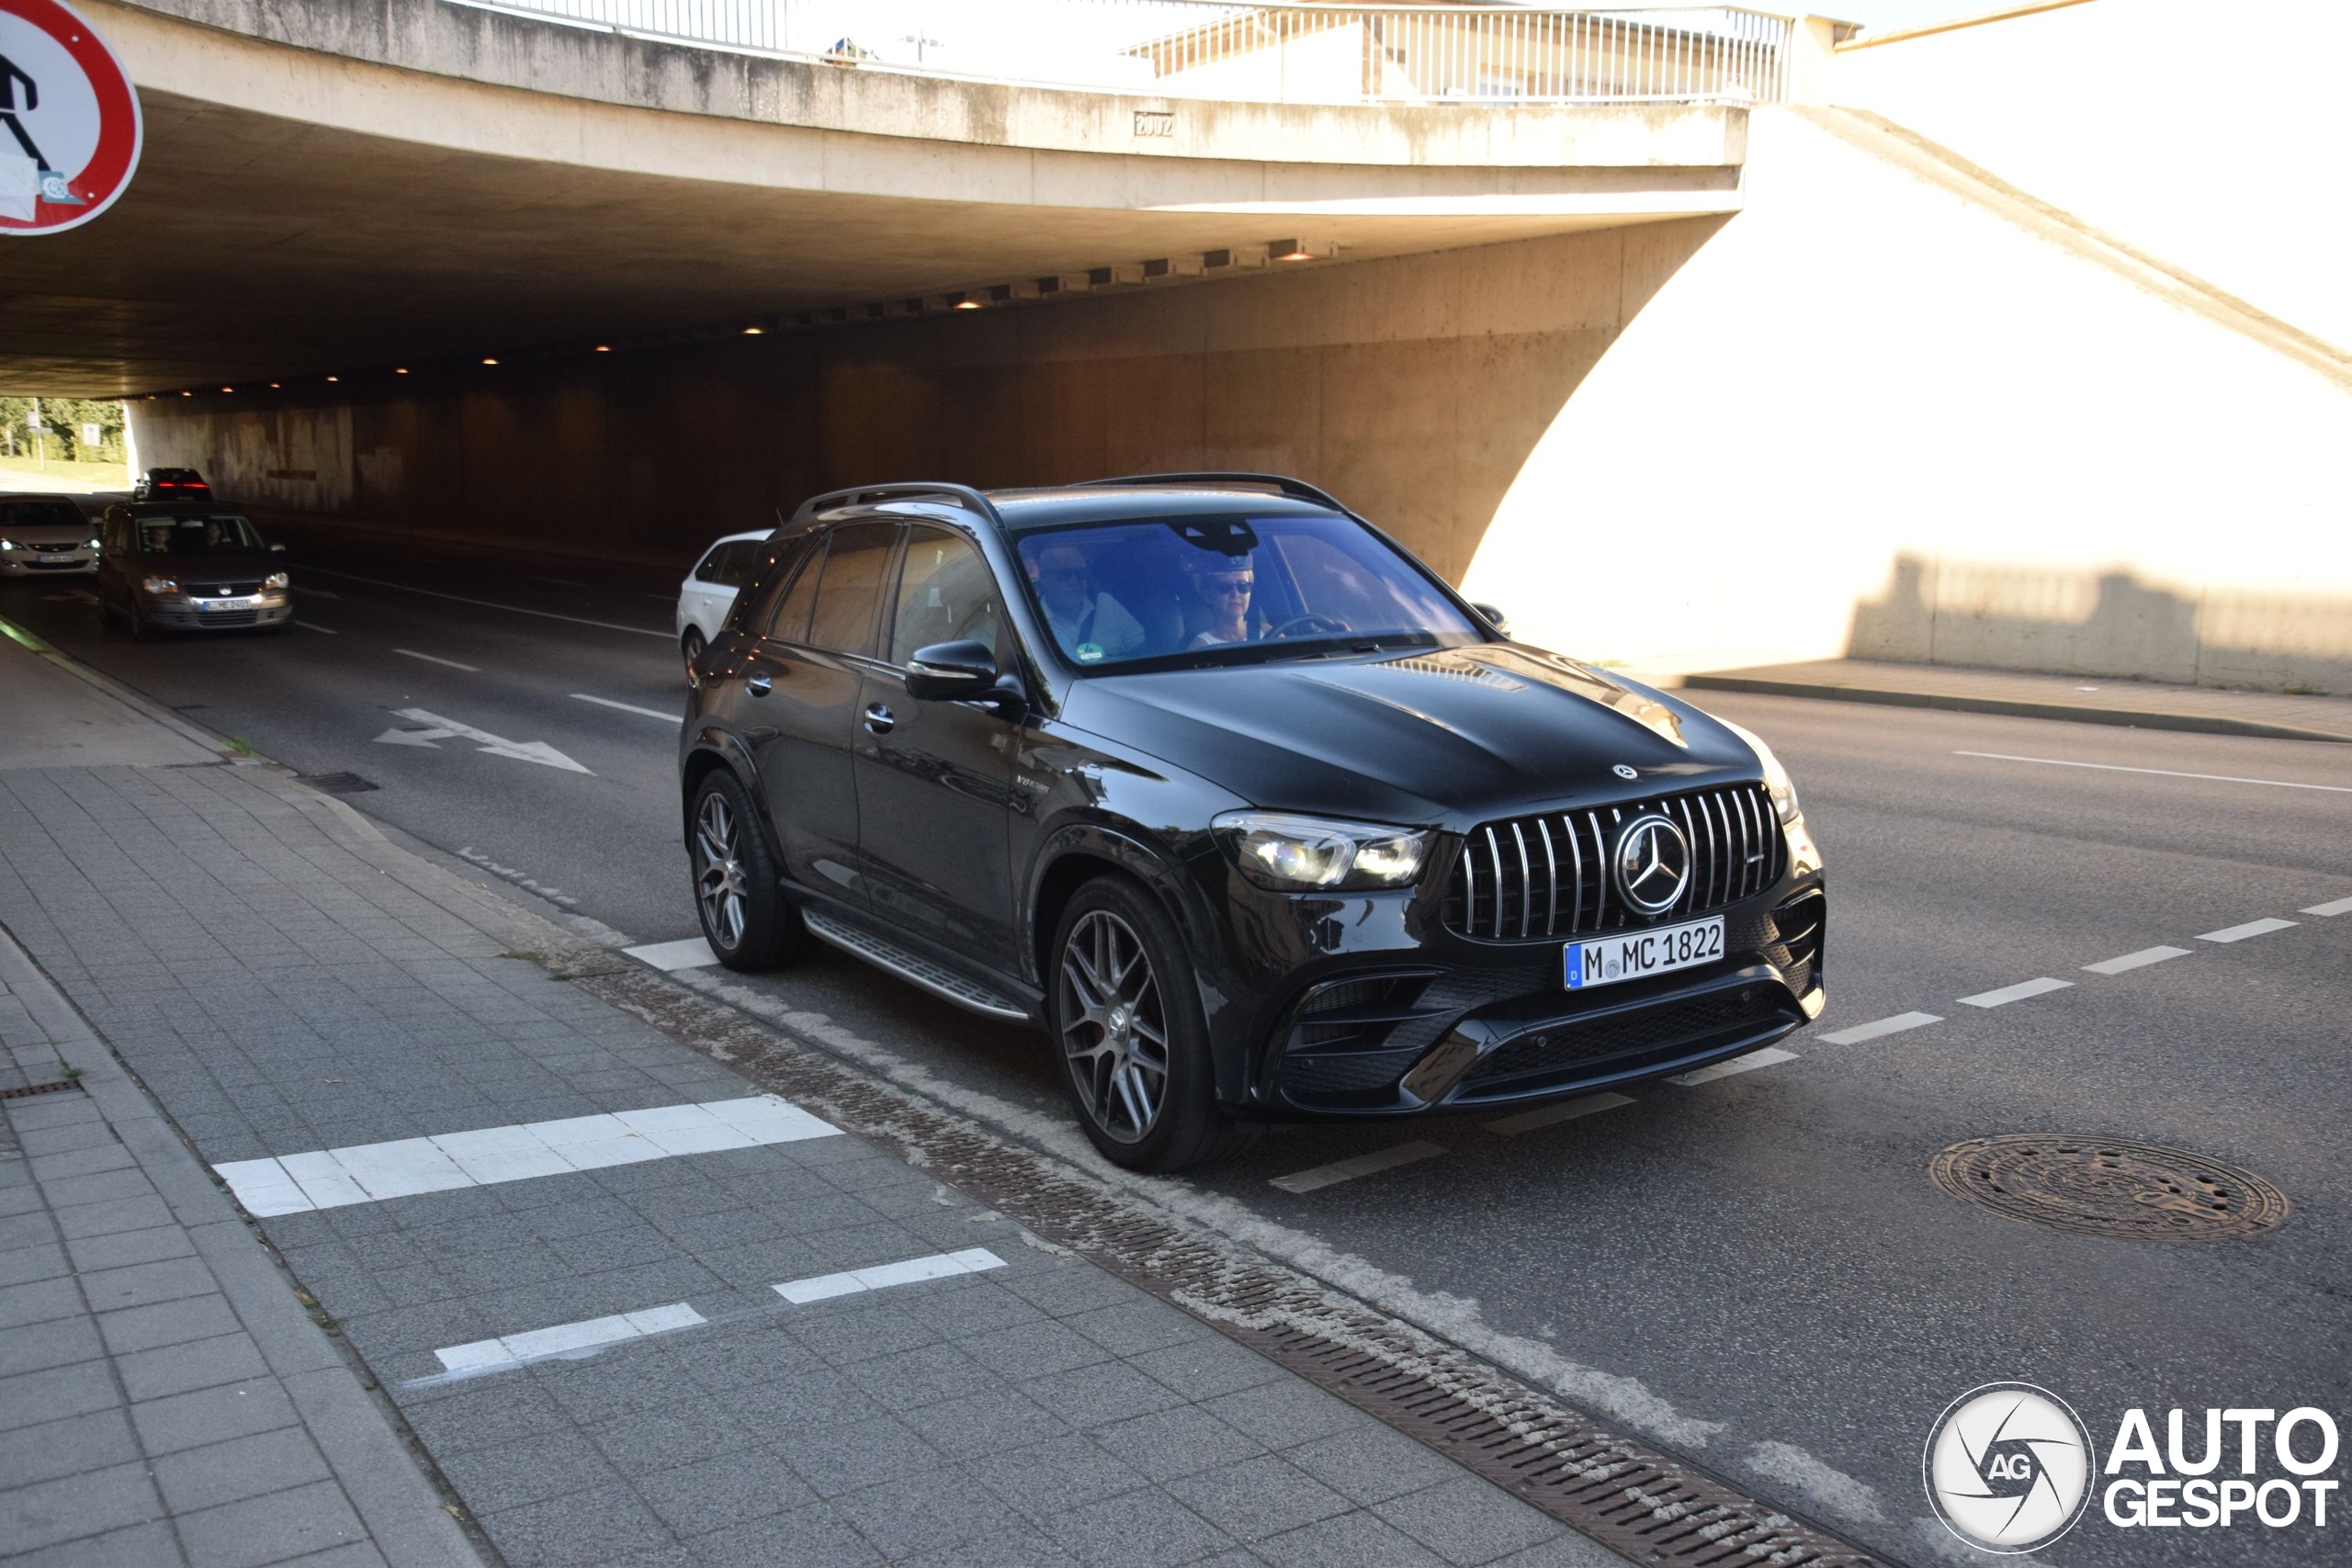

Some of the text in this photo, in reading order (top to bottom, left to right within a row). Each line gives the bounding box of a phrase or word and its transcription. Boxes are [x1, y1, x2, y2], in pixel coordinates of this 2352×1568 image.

[1136, 115, 1172, 138] 2002
[1585, 924, 1720, 980] M MC 1822
[1570, 970, 1577, 981] D
